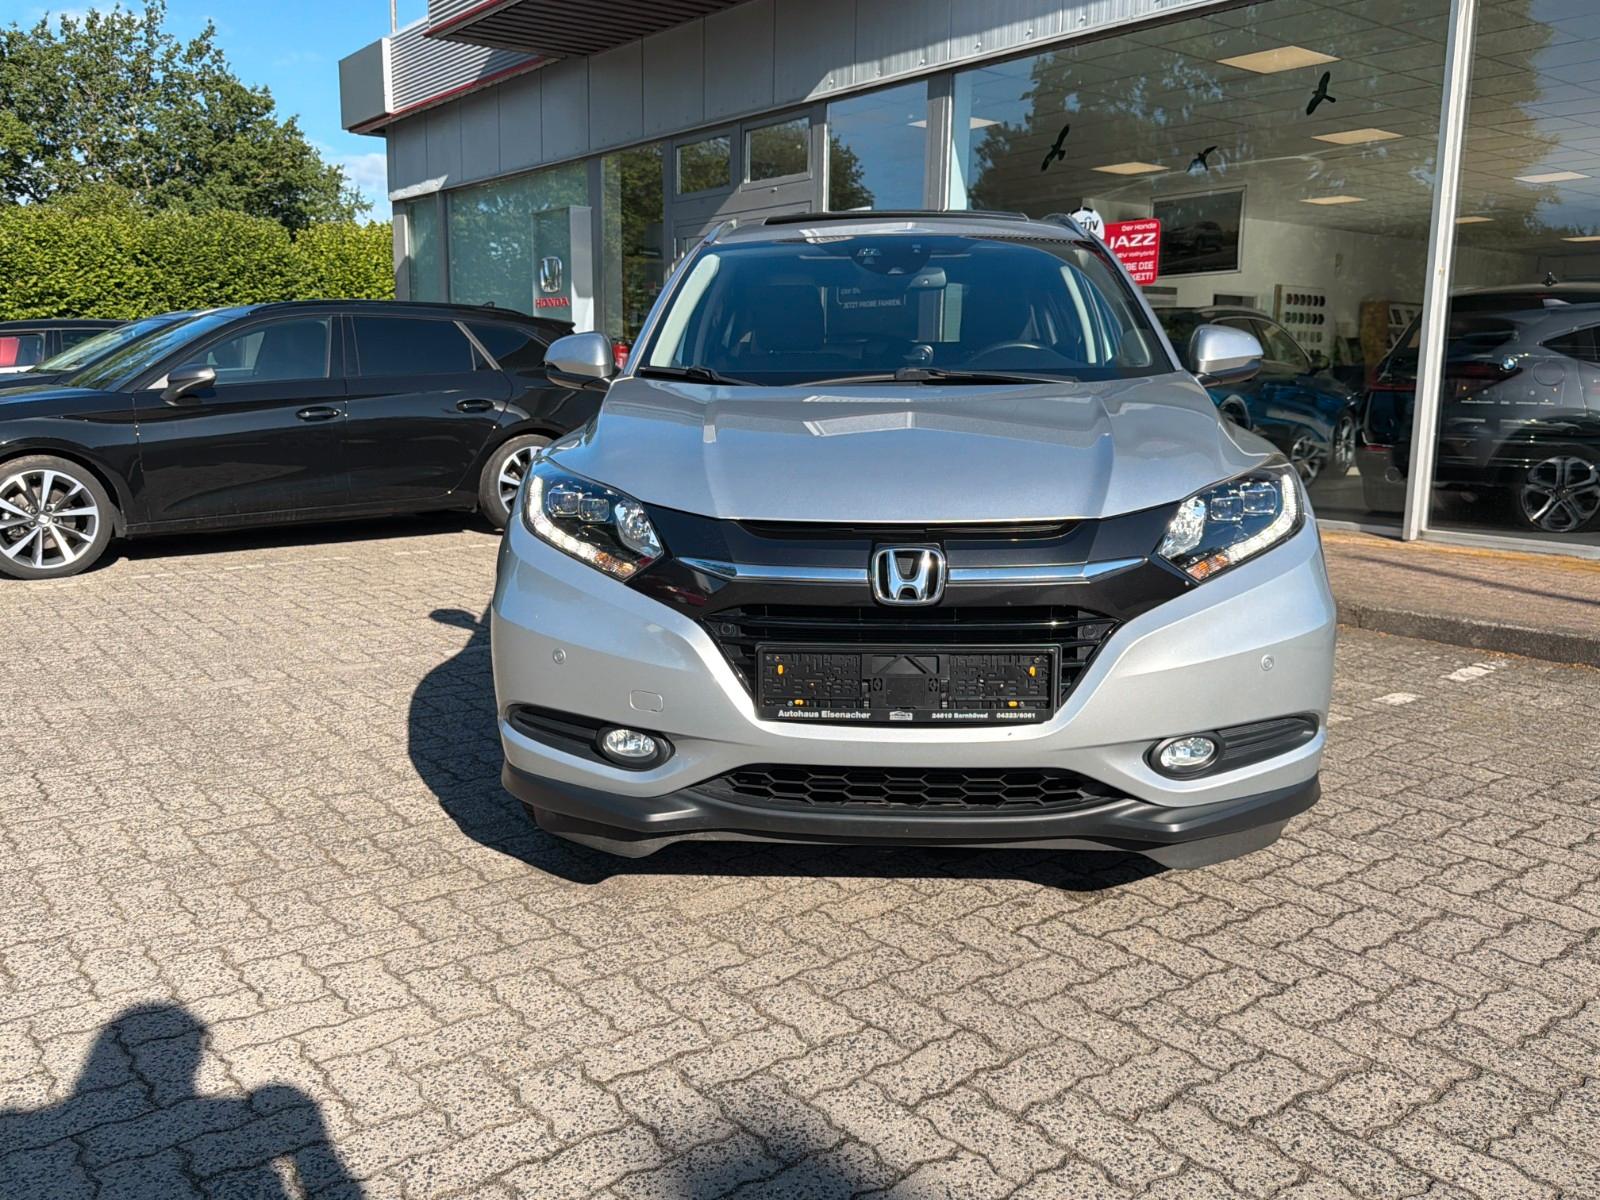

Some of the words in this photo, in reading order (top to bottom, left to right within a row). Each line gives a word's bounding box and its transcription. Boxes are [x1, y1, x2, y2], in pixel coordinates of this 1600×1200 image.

[1134, 222, 1157, 230] Honda
[1110, 232, 1157, 249] JAZZ
[1138, 260, 1154, 270] DIE
[535, 296, 570, 309] HONDA
[777, 709, 820, 718] Autohaus
[820, 710, 872, 719] Eisenacher
